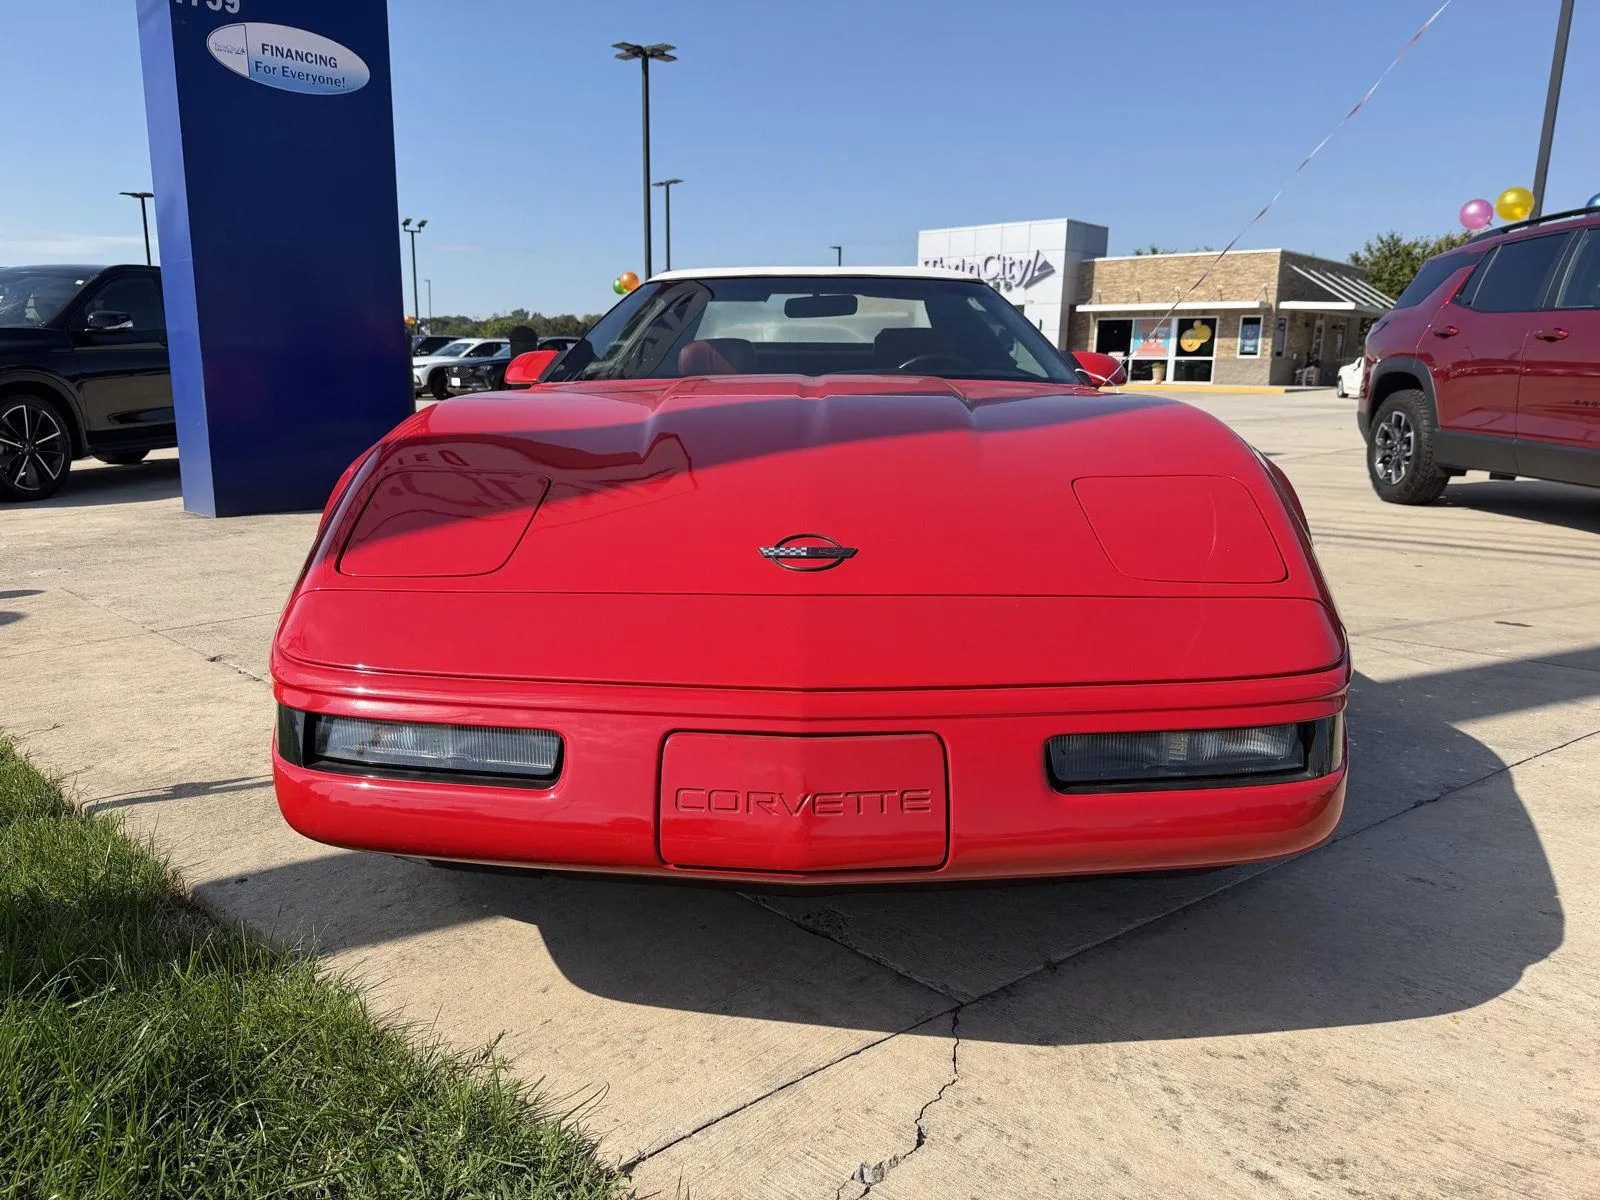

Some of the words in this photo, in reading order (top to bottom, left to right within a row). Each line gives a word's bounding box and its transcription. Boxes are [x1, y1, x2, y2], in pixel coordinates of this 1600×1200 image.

[261, 43, 338, 69] FINANCING
[255, 61, 277, 75] For
[282, 66, 346, 88] Everyone!
[675, 787, 932, 816] CORVETTE
